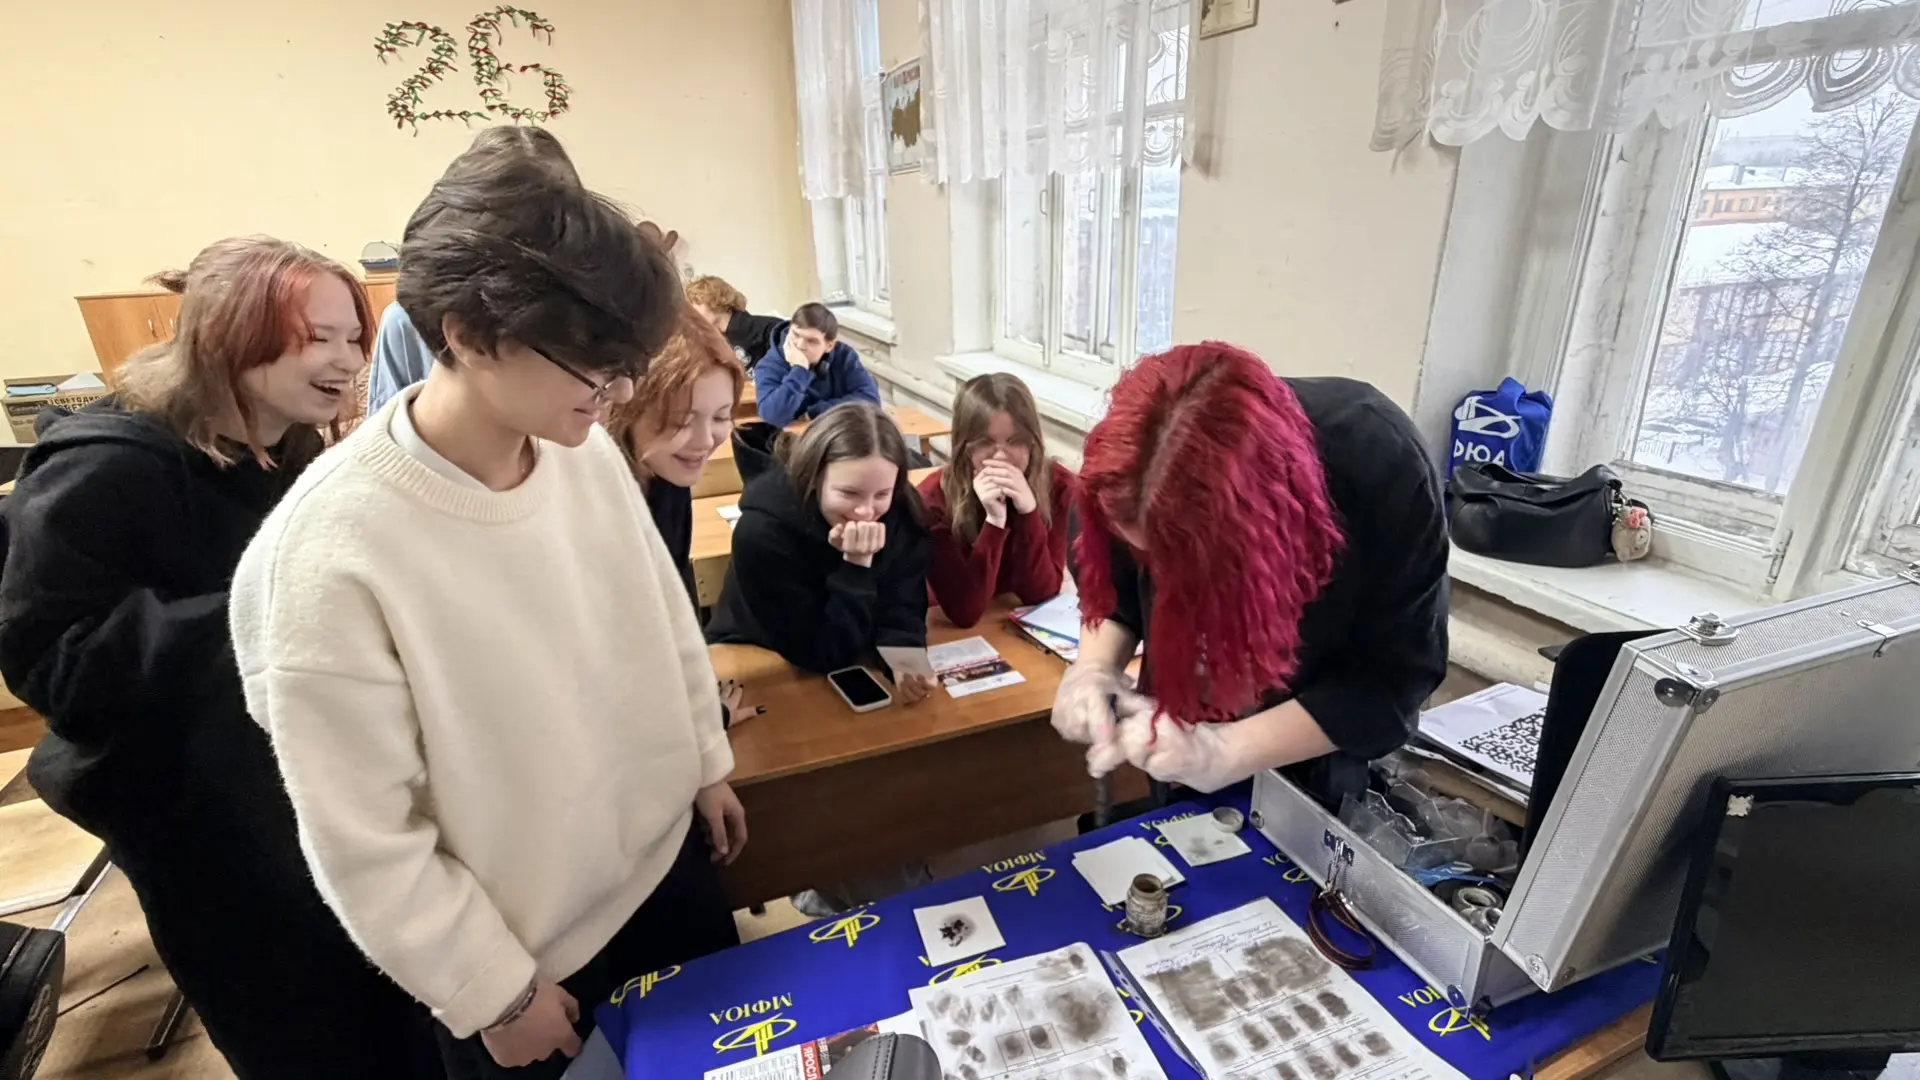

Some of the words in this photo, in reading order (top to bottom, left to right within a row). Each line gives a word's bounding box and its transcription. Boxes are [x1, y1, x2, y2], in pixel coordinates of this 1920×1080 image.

[981, 849, 1047, 875] МФЮА
[709, 992, 793, 1025] МФЮА
[1397, 985, 1442, 1008] ЮА
